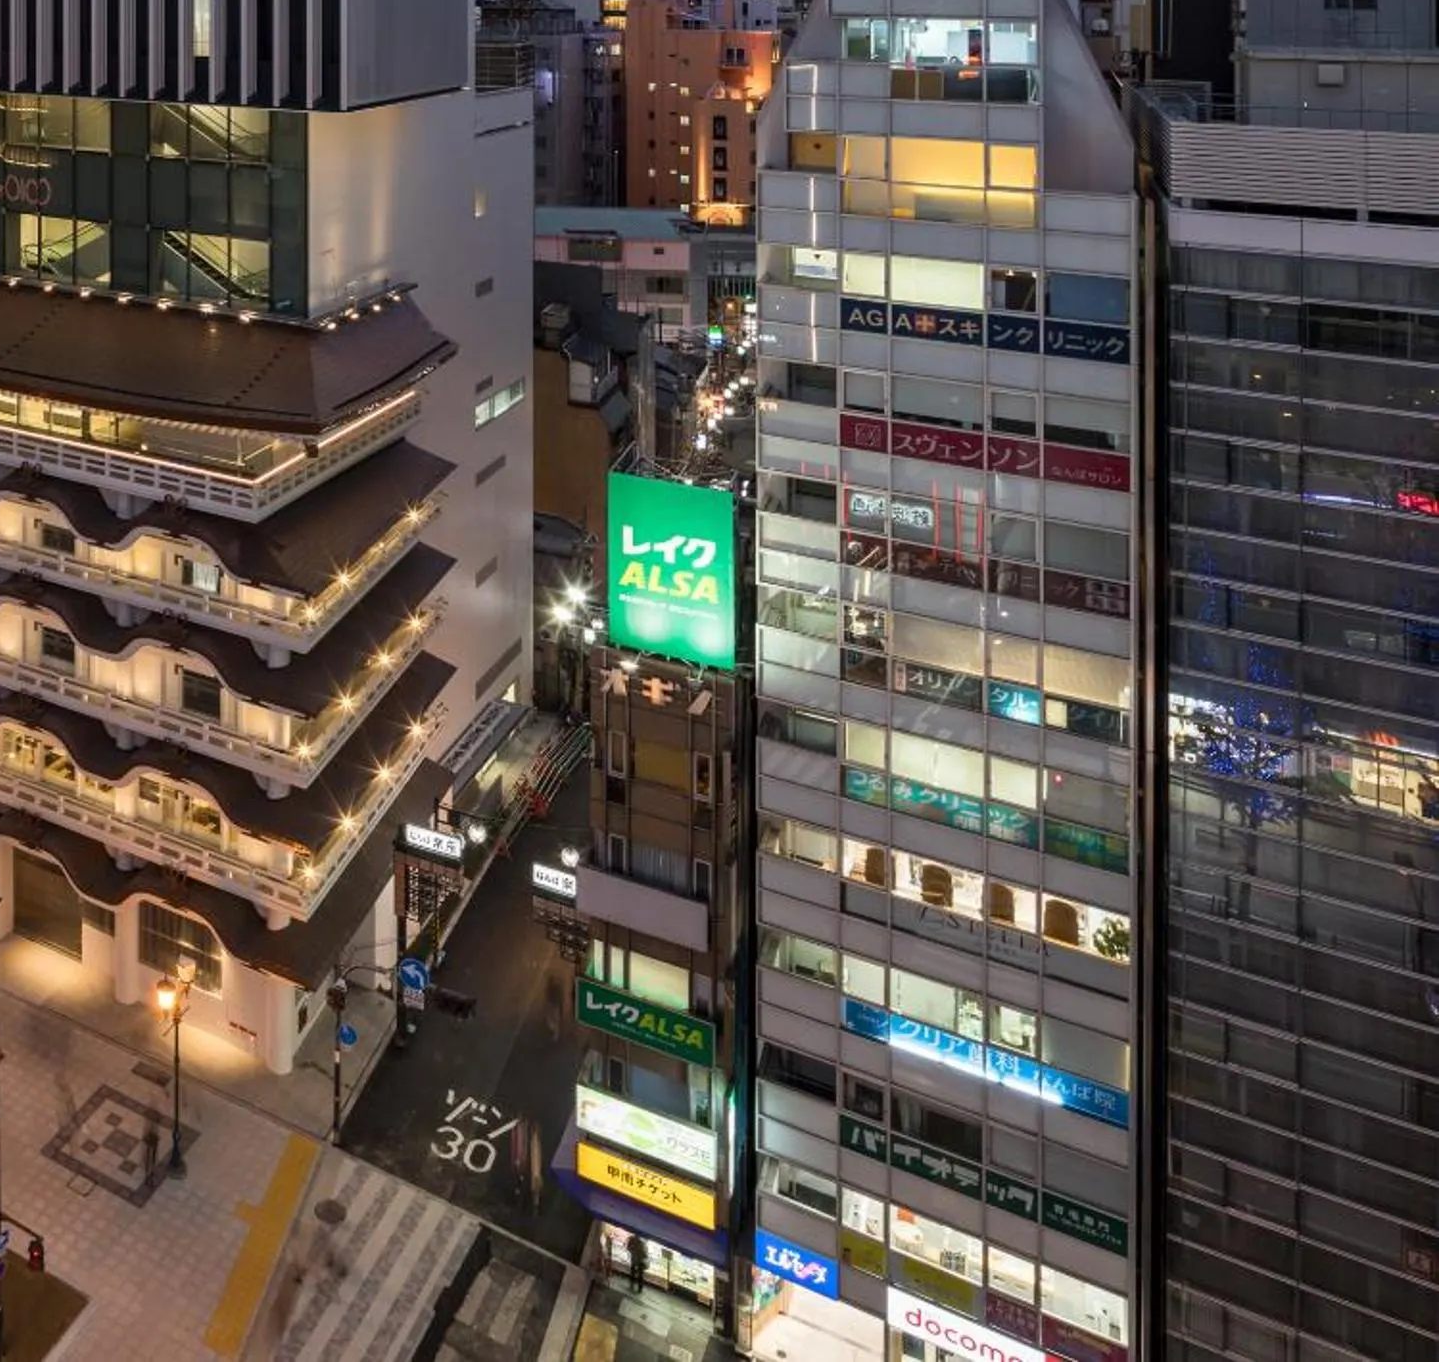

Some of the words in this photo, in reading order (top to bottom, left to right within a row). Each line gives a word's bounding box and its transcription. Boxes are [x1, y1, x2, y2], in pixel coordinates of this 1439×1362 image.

[893, 432, 1040, 470] スヴェンソン
[622, 525, 716, 568] レイク
[619, 561, 719, 605] ALSA
[430, 1125, 496, 1173] 30
